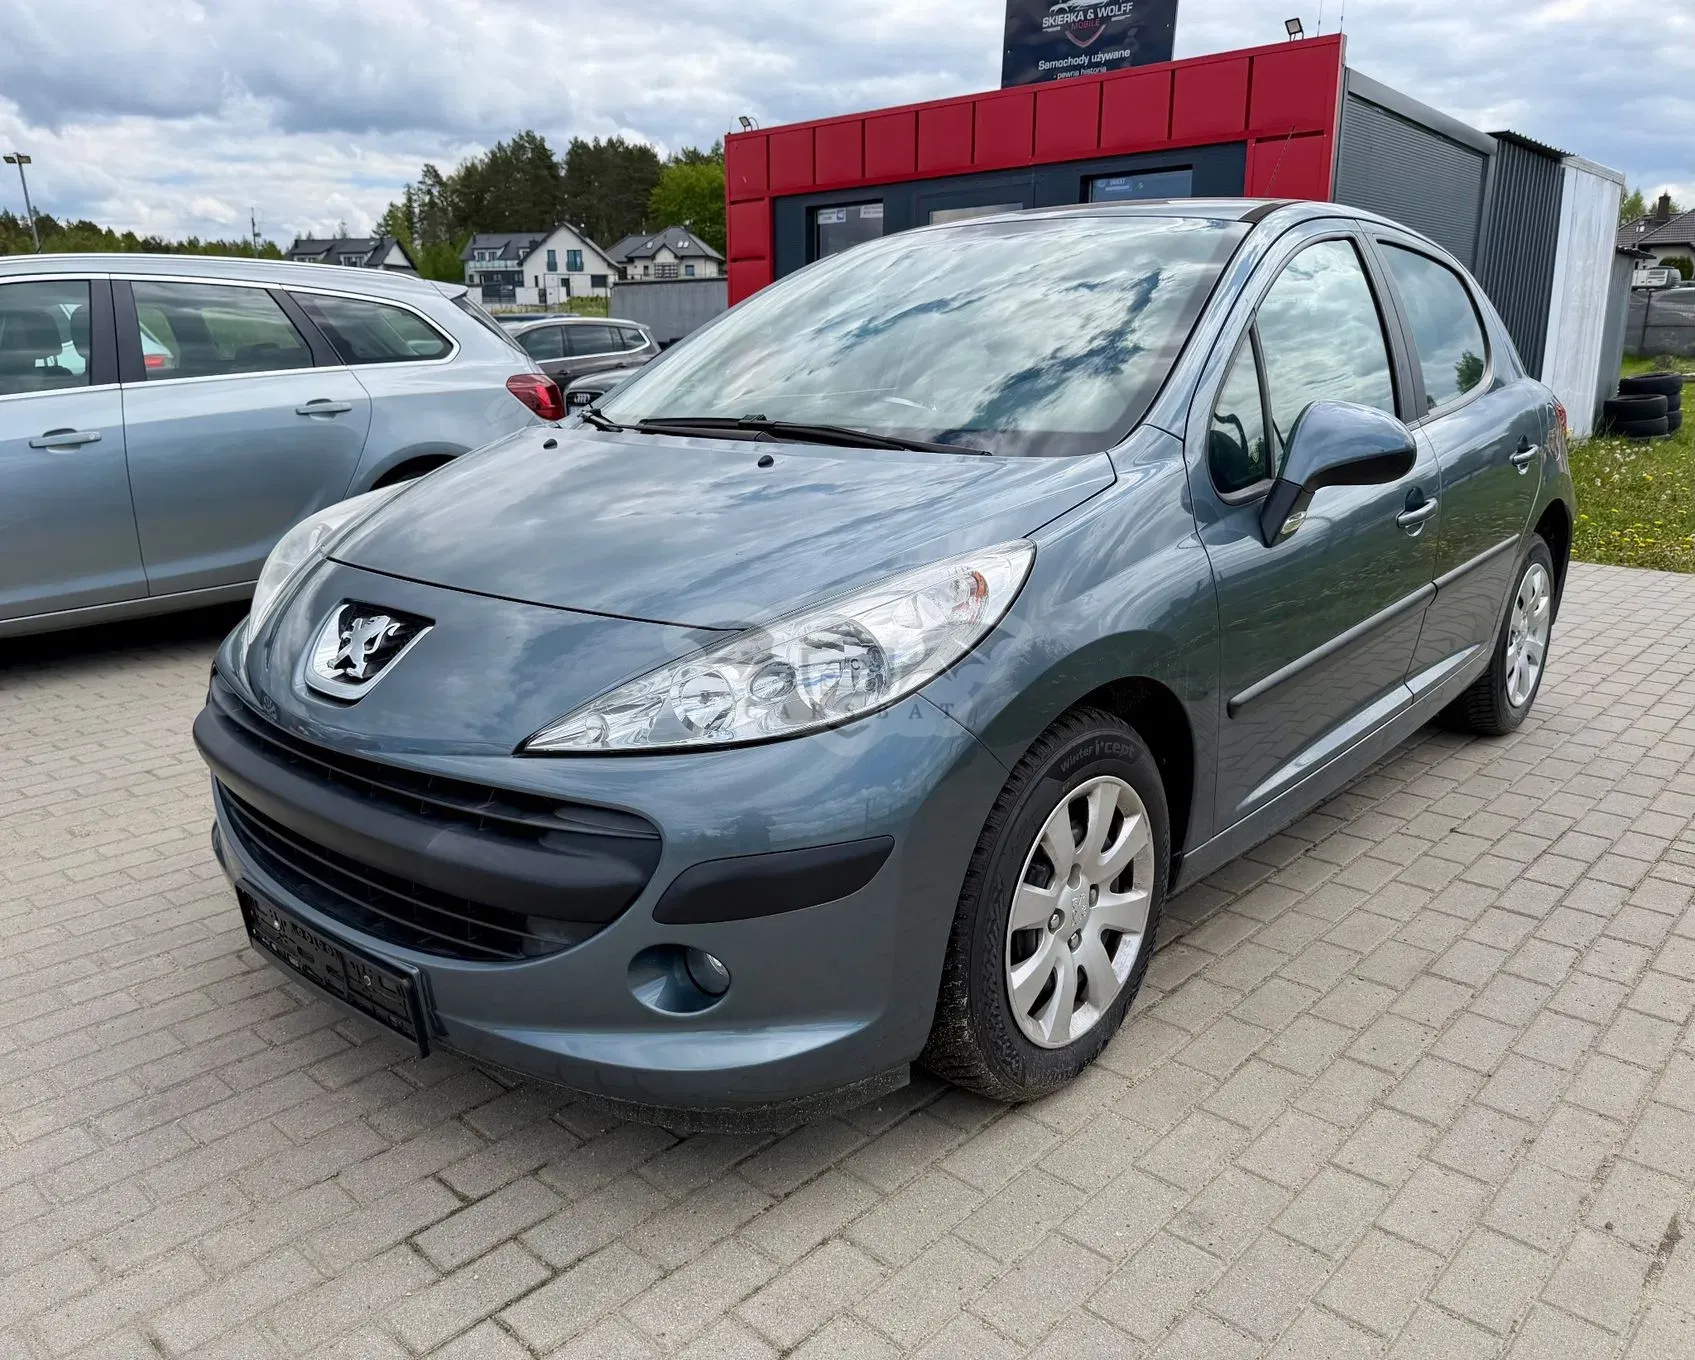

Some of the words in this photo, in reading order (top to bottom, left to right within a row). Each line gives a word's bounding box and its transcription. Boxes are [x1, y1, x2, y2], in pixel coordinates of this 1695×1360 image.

[1042, 11, 1084, 28] SKIERKA
[1087, 9, 1094, 19] &
[1097, 2, 1133, 18] WOLFF
[1038, 54, 1089, 70] Samochody
[1091, 49, 1131, 63] używane
